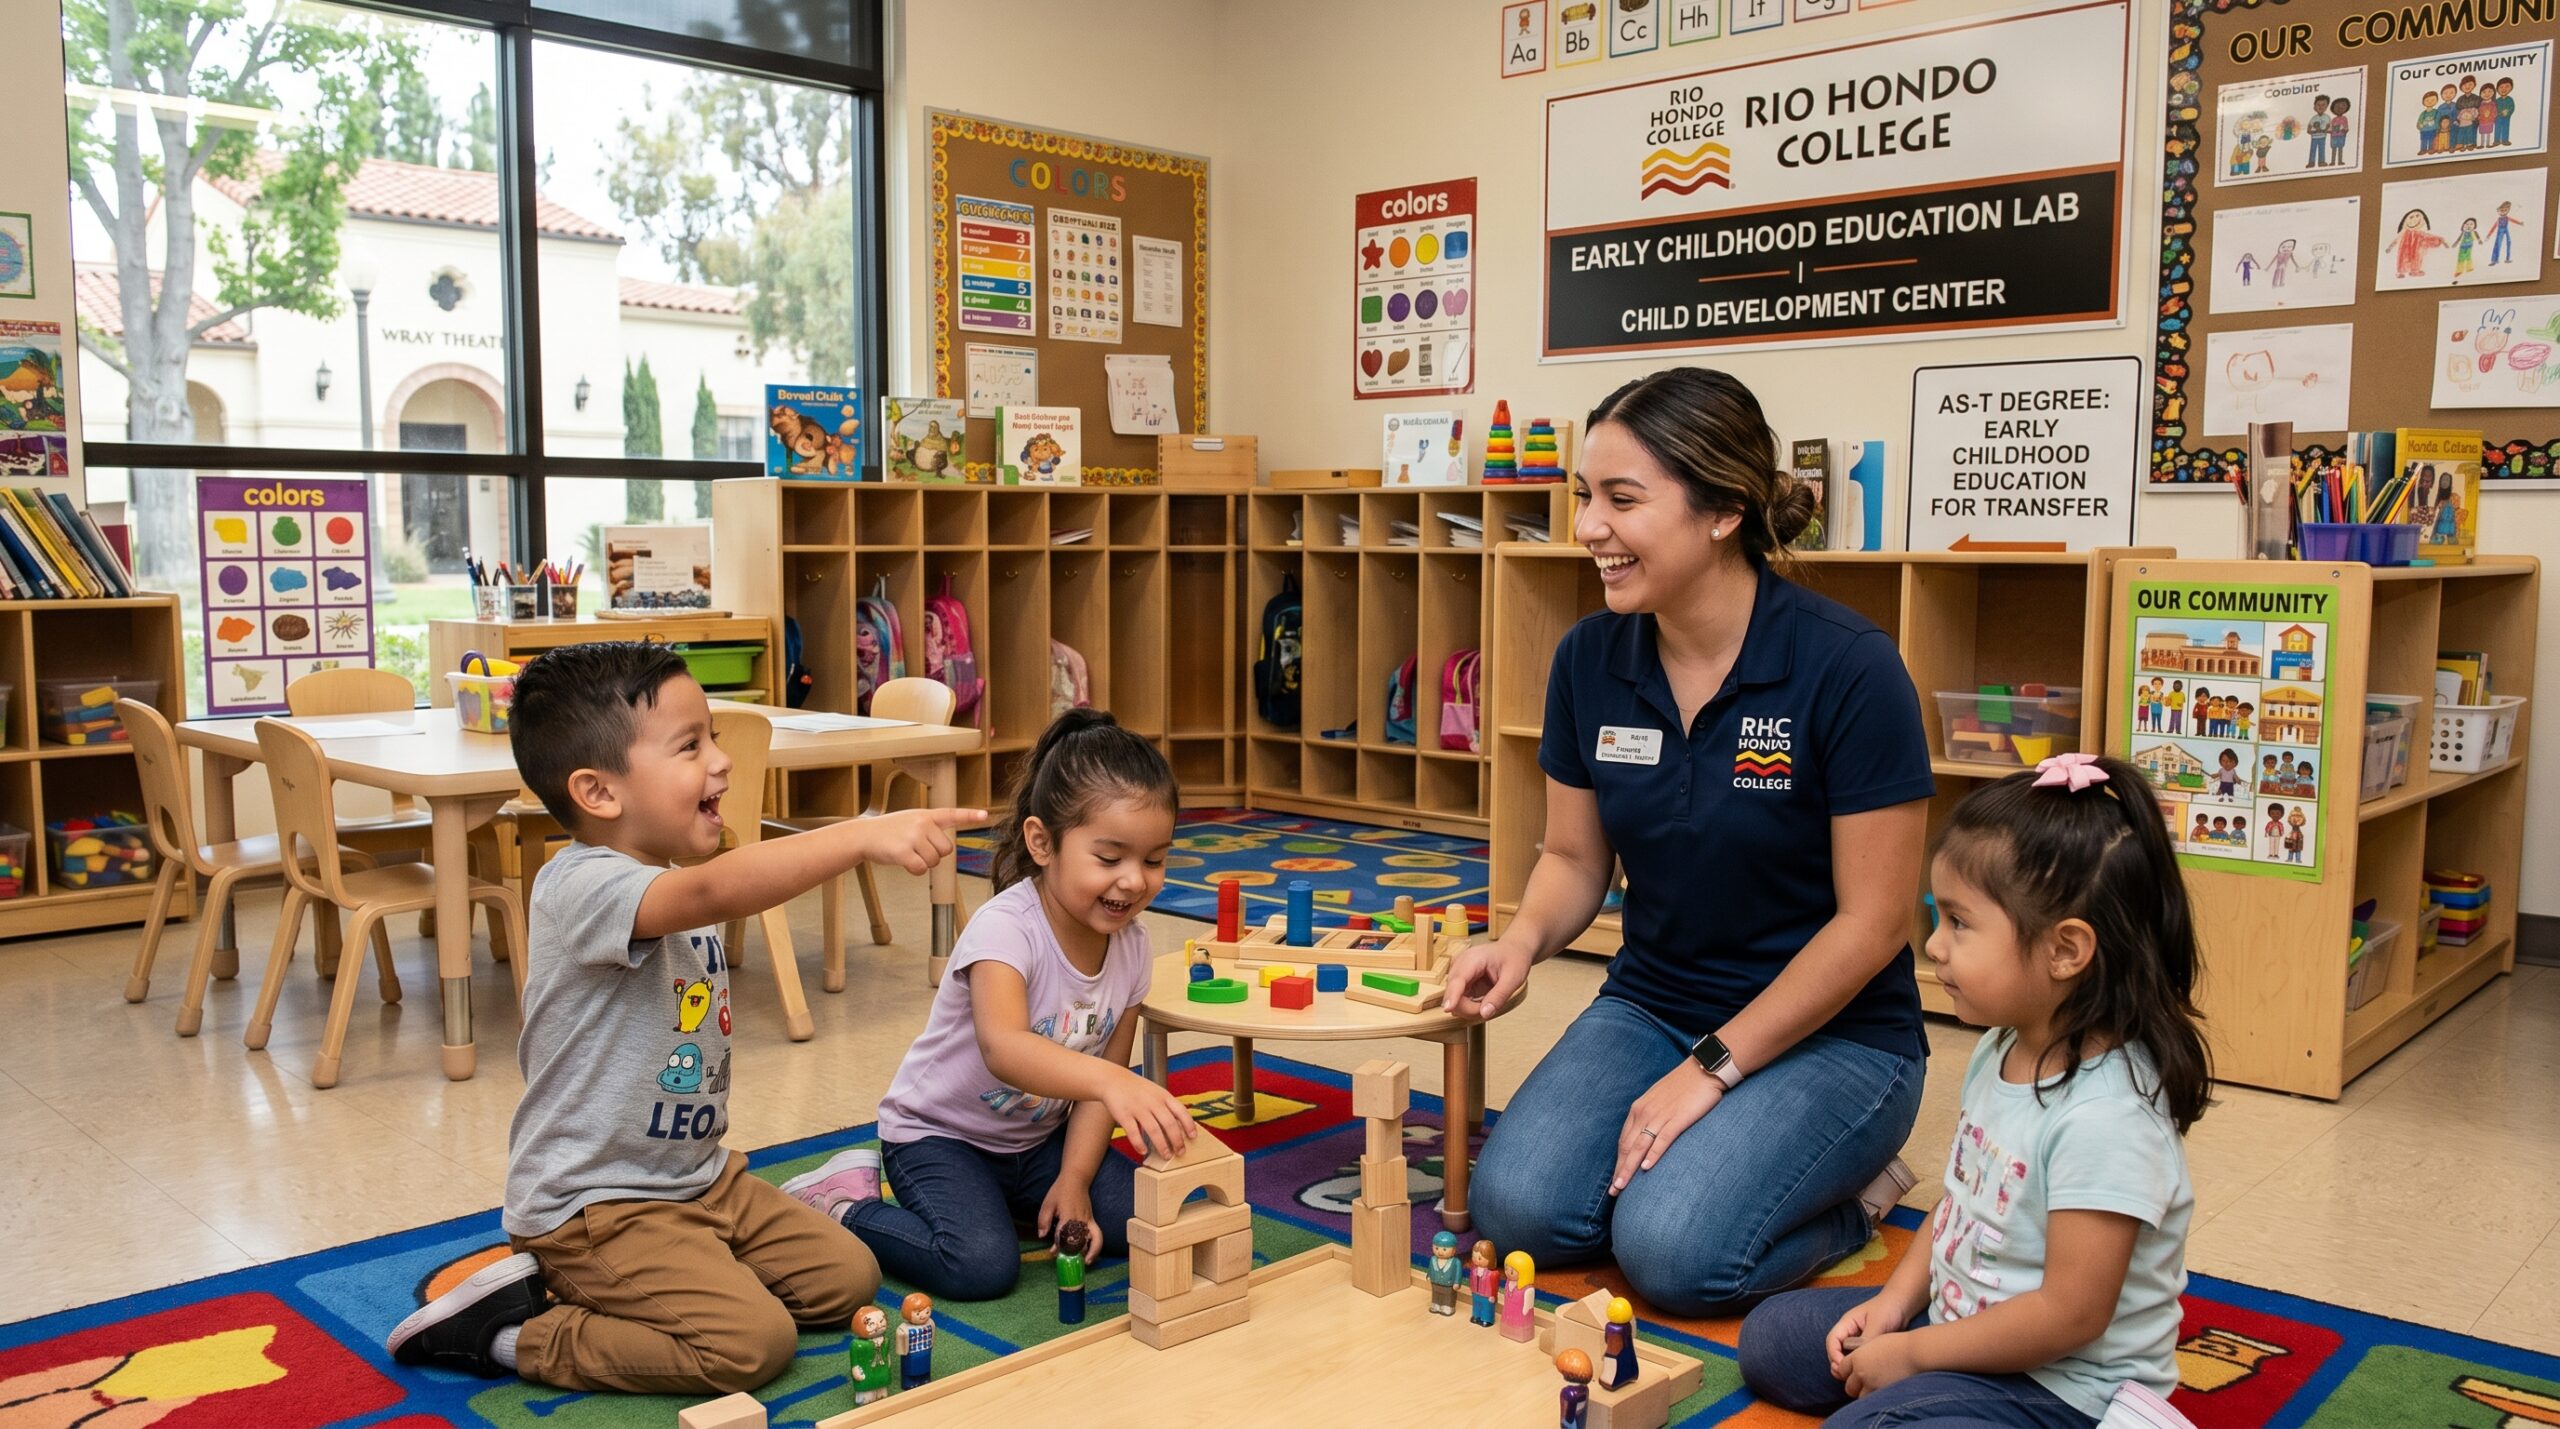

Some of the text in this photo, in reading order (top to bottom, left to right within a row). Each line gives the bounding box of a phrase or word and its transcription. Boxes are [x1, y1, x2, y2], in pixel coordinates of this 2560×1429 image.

[1620, 19, 1648, 42] Cc
[1679, 8, 1709, 31] Hh
[1510, 42, 1537, 65] Aa
[1565, 31, 1590, 54] Bb
[2229, 23, 2313, 65] OUR
[2434, 52, 2538, 77] COMMUNITY
[1669, 86, 1704, 107] RIO
[1745, 58, 1998, 129] RIO HONDO
[1650, 99, 1724, 128] HONDO
[1646, 120, 1726, 146] COLLEGE
[1776, 113, 1951, 168] COLLEGE
[1011, 159, 1127, 202] COLORS
[1381, 189, 1449, 220] colors
[1016, 232, 1026, 244] 3
[1571, 192, 2080, 272] EARLY CHILDHOOD EDUCATION LAB
[1016, 249, 1026, 261] 7
[1621, 278, 2006, 333] CHILD DEVELOPMENT CENTER
[382, 328, 435, 345] WRAY
[1938, 388, 2110, 414] AS-T DEGREE:
[1983, 419, 2059, 439] EARLY
[1953, 445, 2091, 466] CHILDHOOD
[1953, 471, 2087, 491] EDUCATION
[243, 482, 326, 507] colors
[1931, 497, 2109, 518] FOR TRANSFER
[2137, 589, 2329, 615] OUR COMMUNITY
[1741, 717, 1792, 738] RHC
[1733, 777, 1792, 790] COLLEGE
